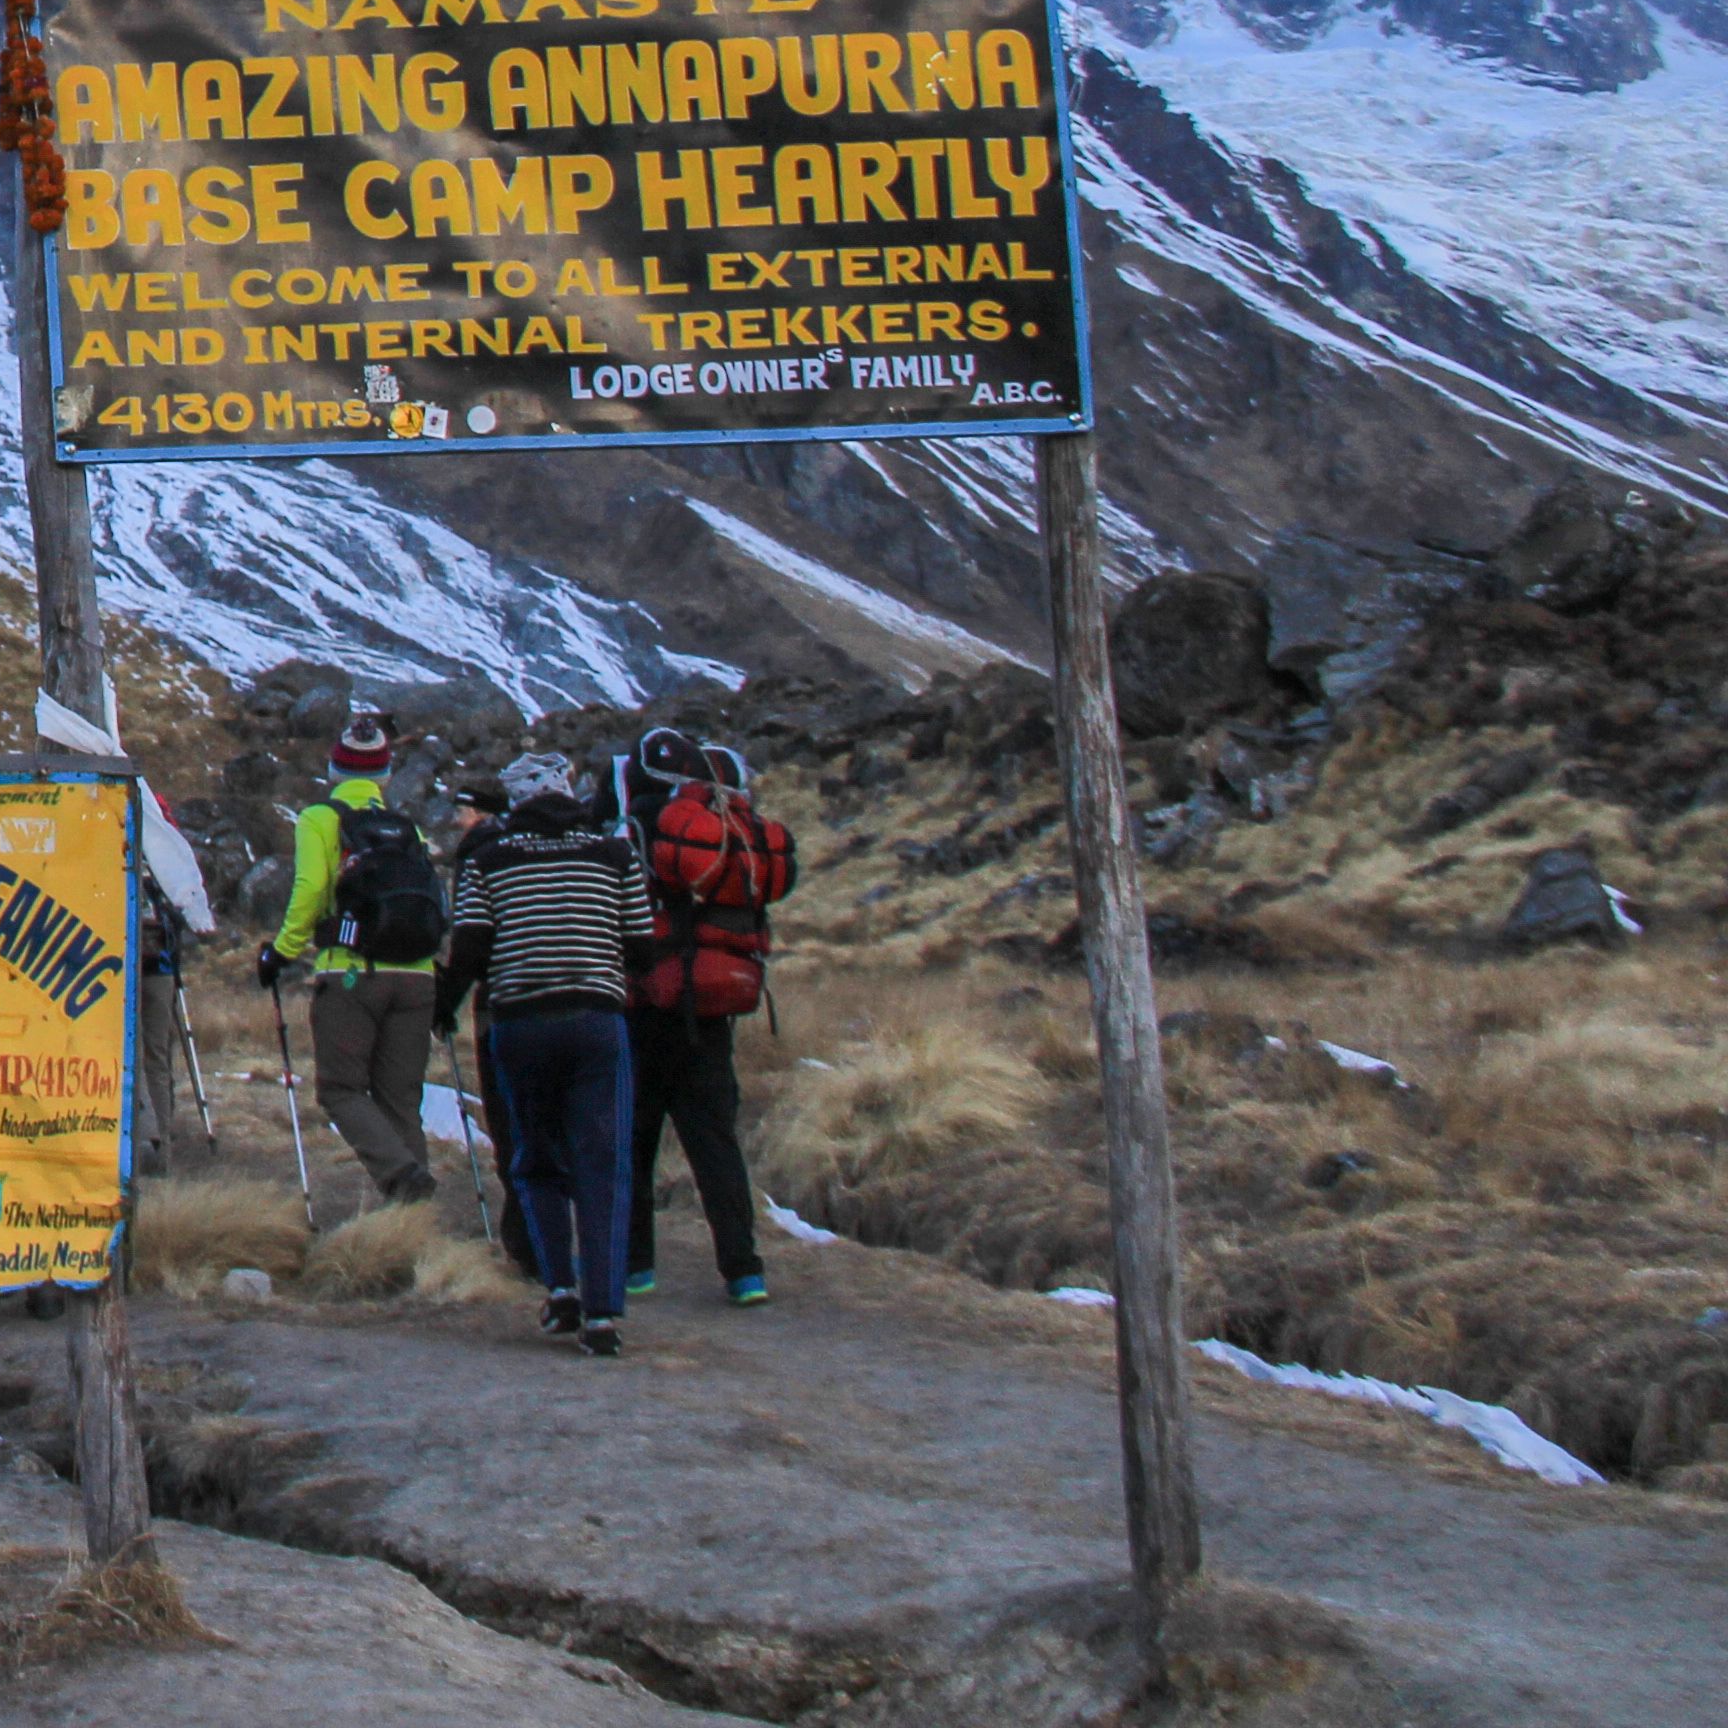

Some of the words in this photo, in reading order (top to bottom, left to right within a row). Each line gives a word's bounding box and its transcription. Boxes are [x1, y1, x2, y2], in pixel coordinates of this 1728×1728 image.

[55, 51, 467, 145] AMAZING
[488, 29, 1040, 131] ANNAPURNA
[63, 163, 311, 251] BASE
[344, 153, 615, 241] CAMP
[635, 136, 1051, 232] HEARTLY
[68, 263, 431, 313] WELCOME
[452, 260, 537, 299] TO
[556, 257, 689, 297] ALL
[706, 242, 1055, 292] EXTERNAL
[70, 328, 228, 369] AND
[244, 315, 607, 365] INTERNAL
[637, 299, 1040, 351] TREKKERS.
[570, 364, 695, 400] LODGE
[849, 353, 977, 390] FAMILY
[970, 380, 1063, 406] A.B.C.
[97, 391, 255, 436] 4130
[4, 1200, 34, 1229] The
[52, 1238, 105, 1274] Nepal
